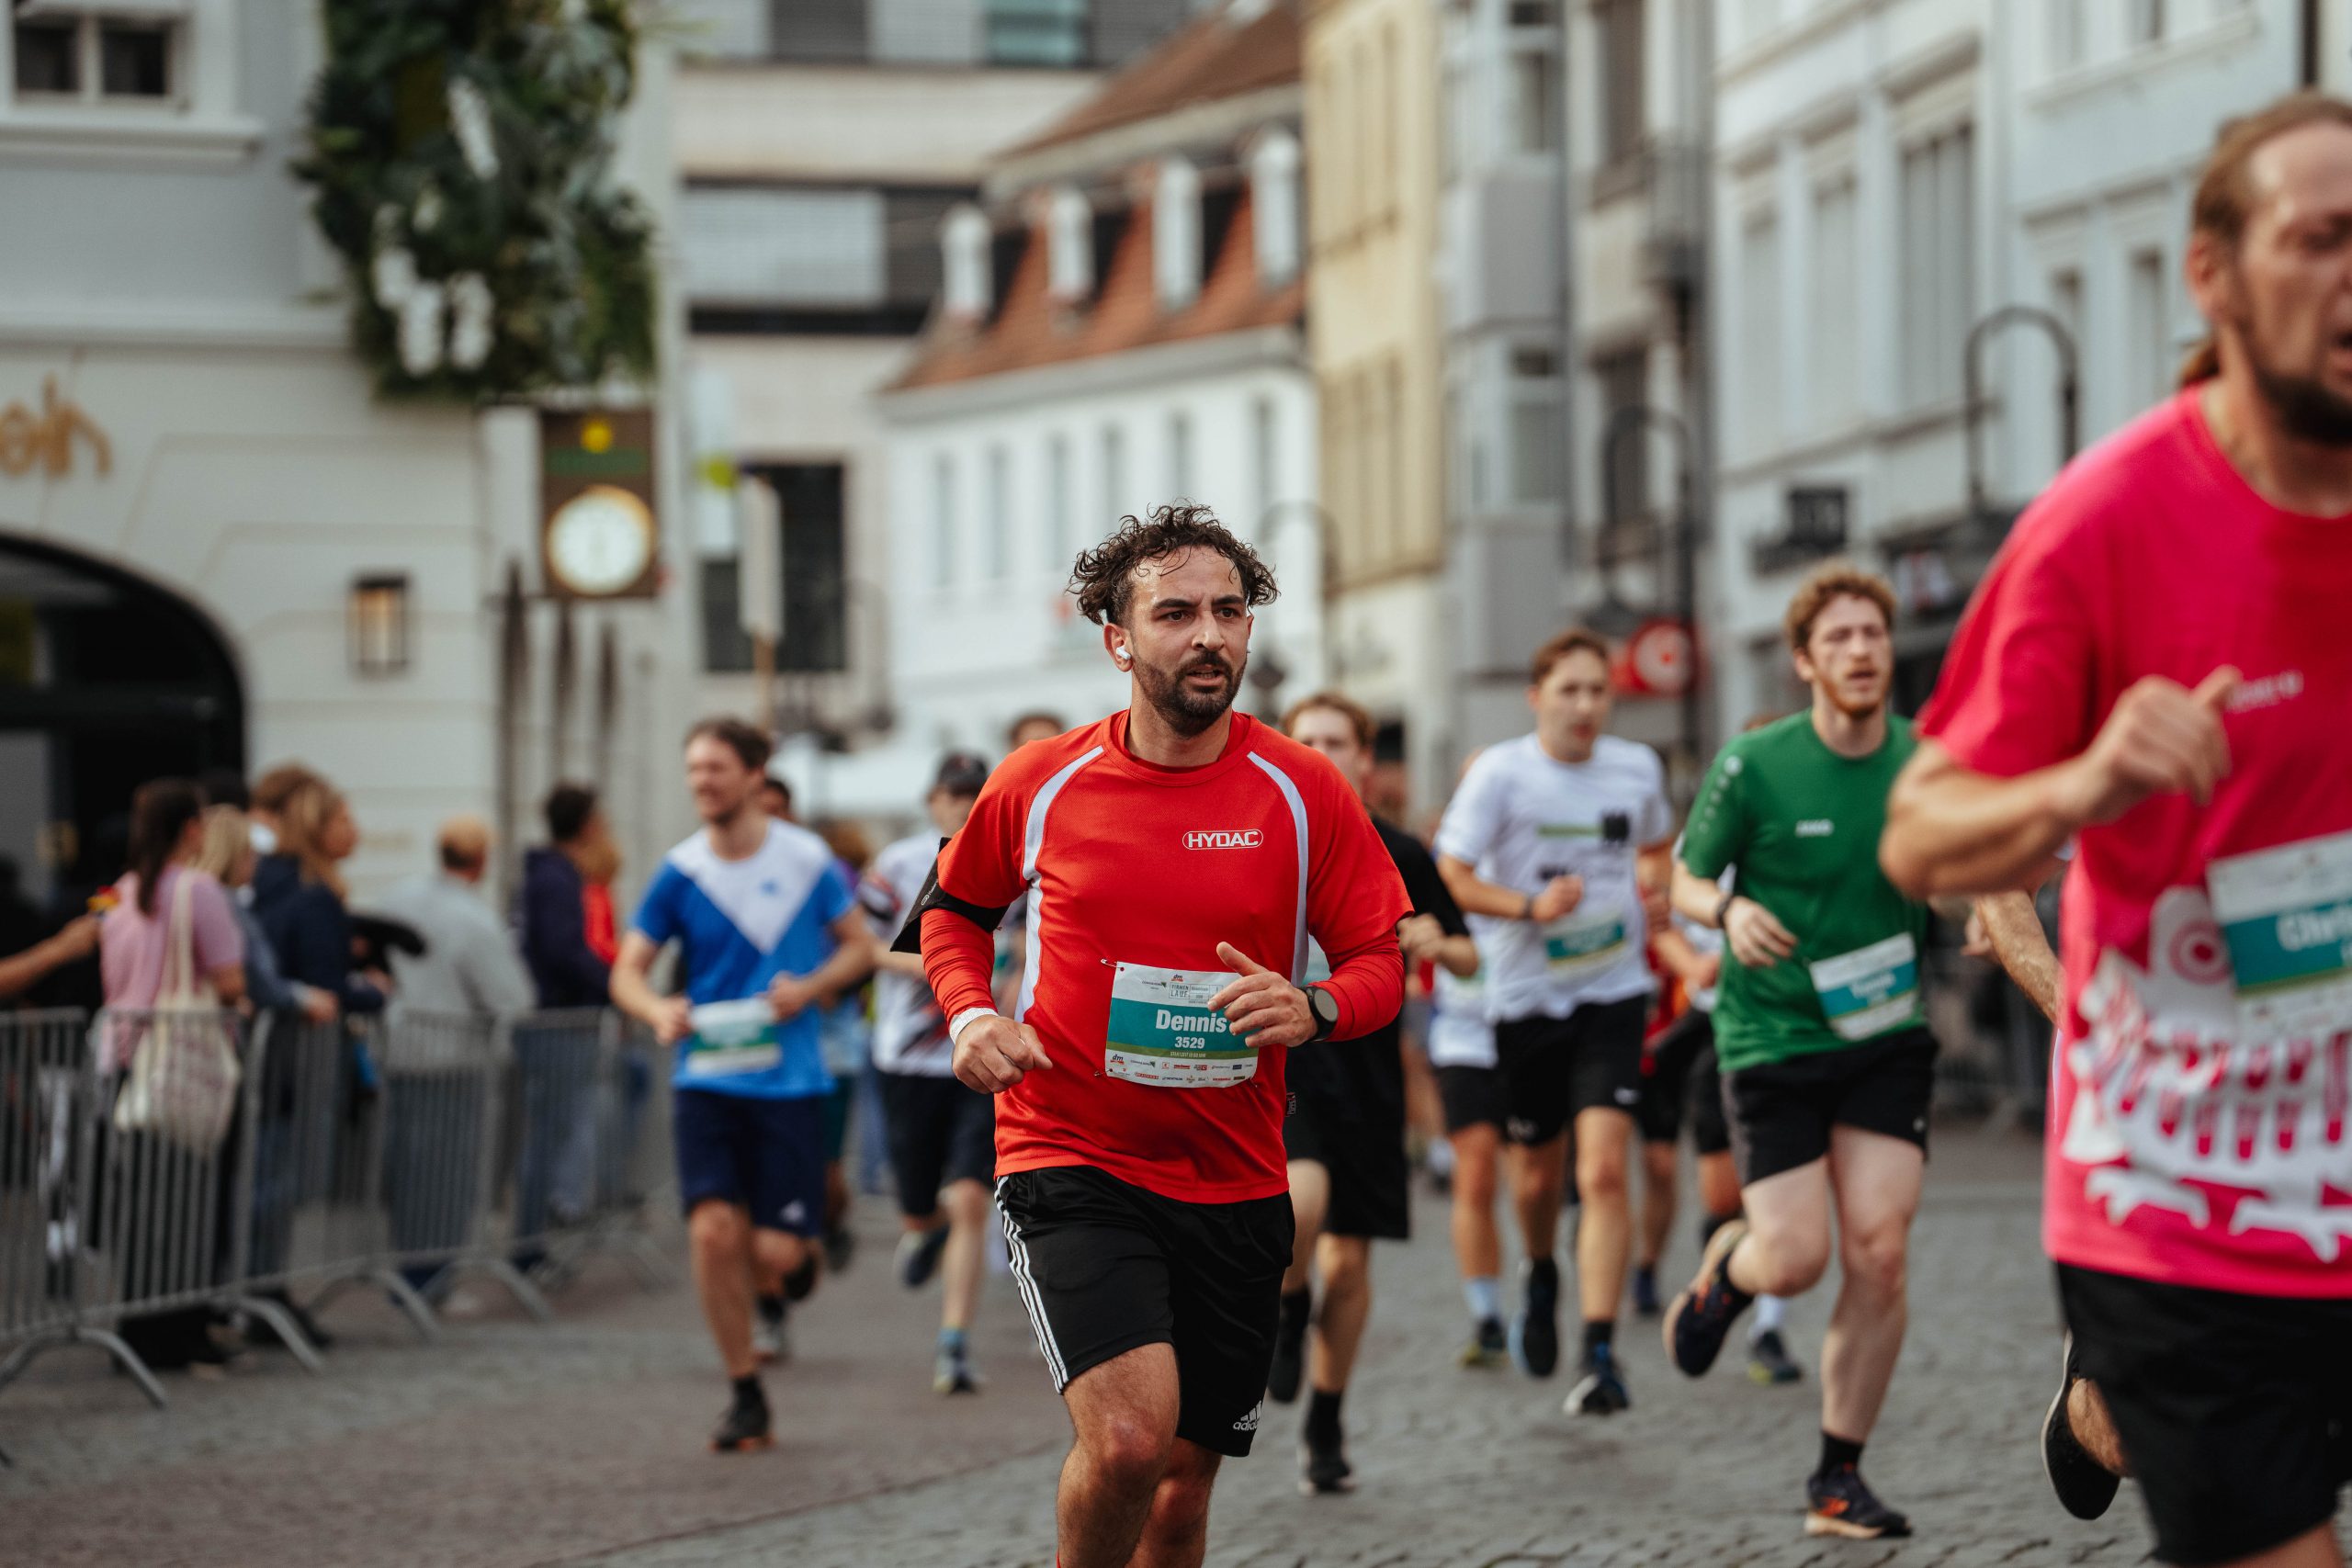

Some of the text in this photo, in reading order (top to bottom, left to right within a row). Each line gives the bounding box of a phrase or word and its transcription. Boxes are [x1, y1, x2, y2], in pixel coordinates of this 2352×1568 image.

[1188, 830, 1259, 848] HYDAC
[1155, 1009, 1227, 1033] Dennis
[1174, 1036, 1205, 1050] 3529
